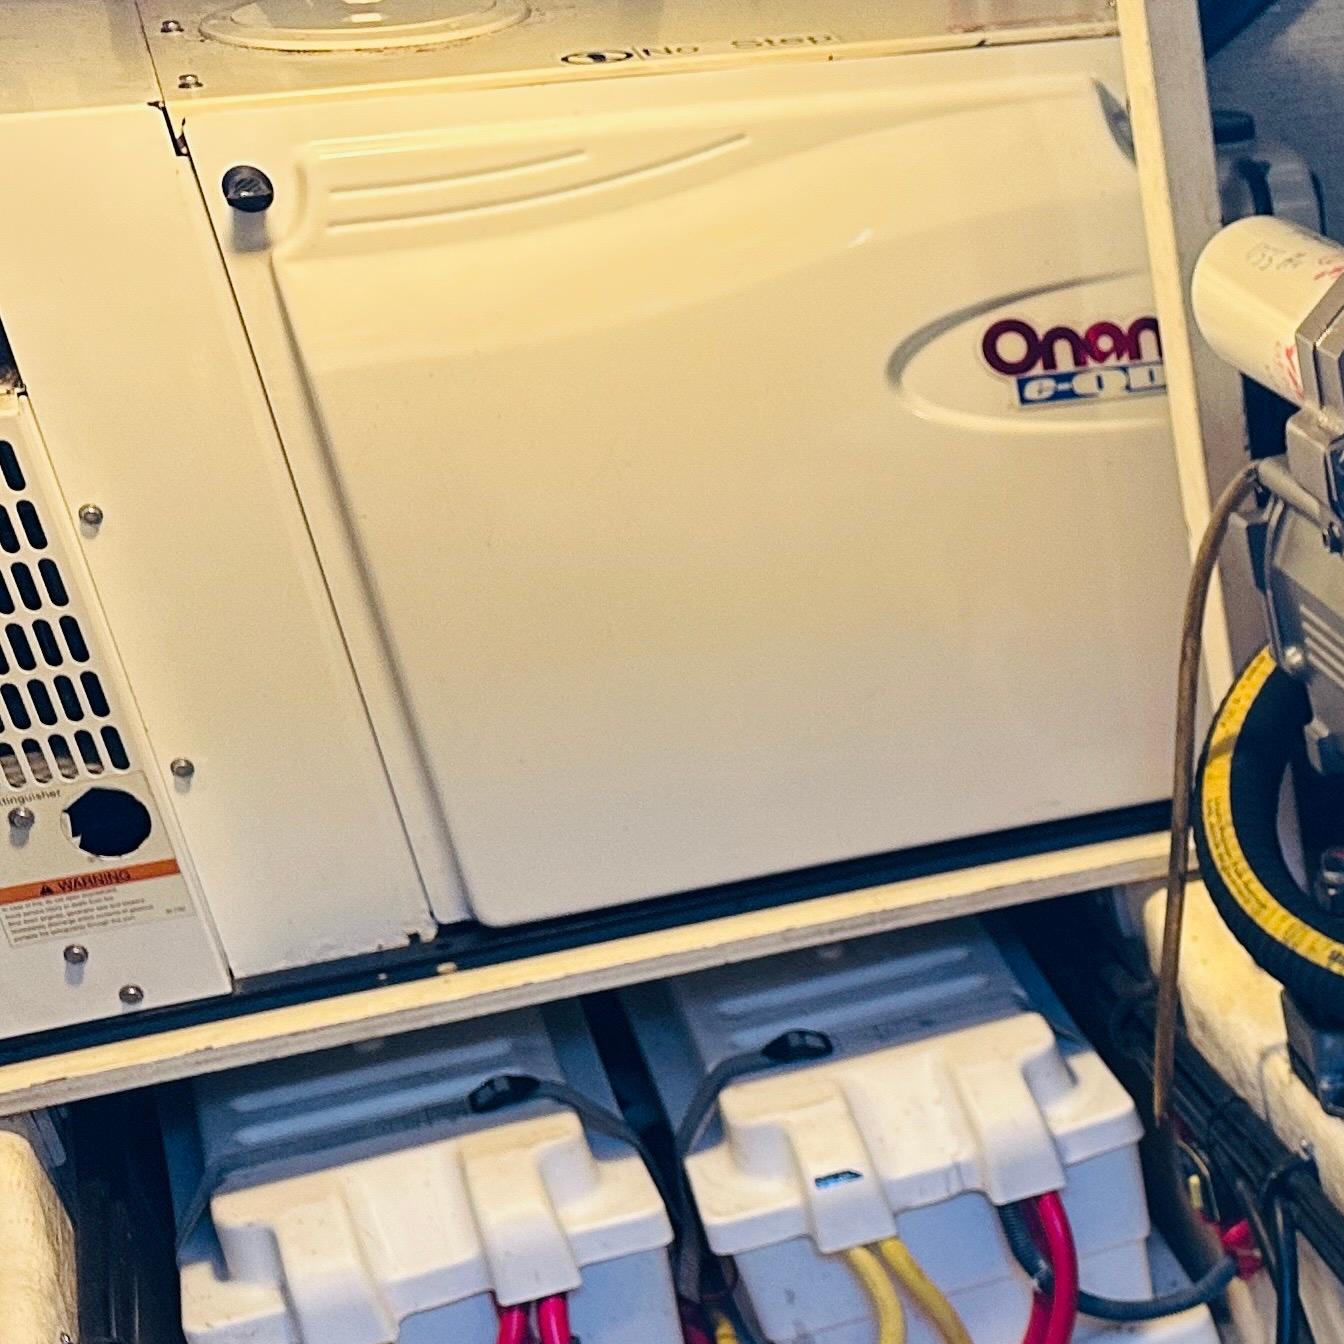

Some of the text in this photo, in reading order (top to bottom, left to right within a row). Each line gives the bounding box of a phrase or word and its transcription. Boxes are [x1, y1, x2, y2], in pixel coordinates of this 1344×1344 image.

[983, 317, 1164, 376] Onan
[0, 790, 61, 806] tinguisher
[58, 870, 132, 893] WARNING
